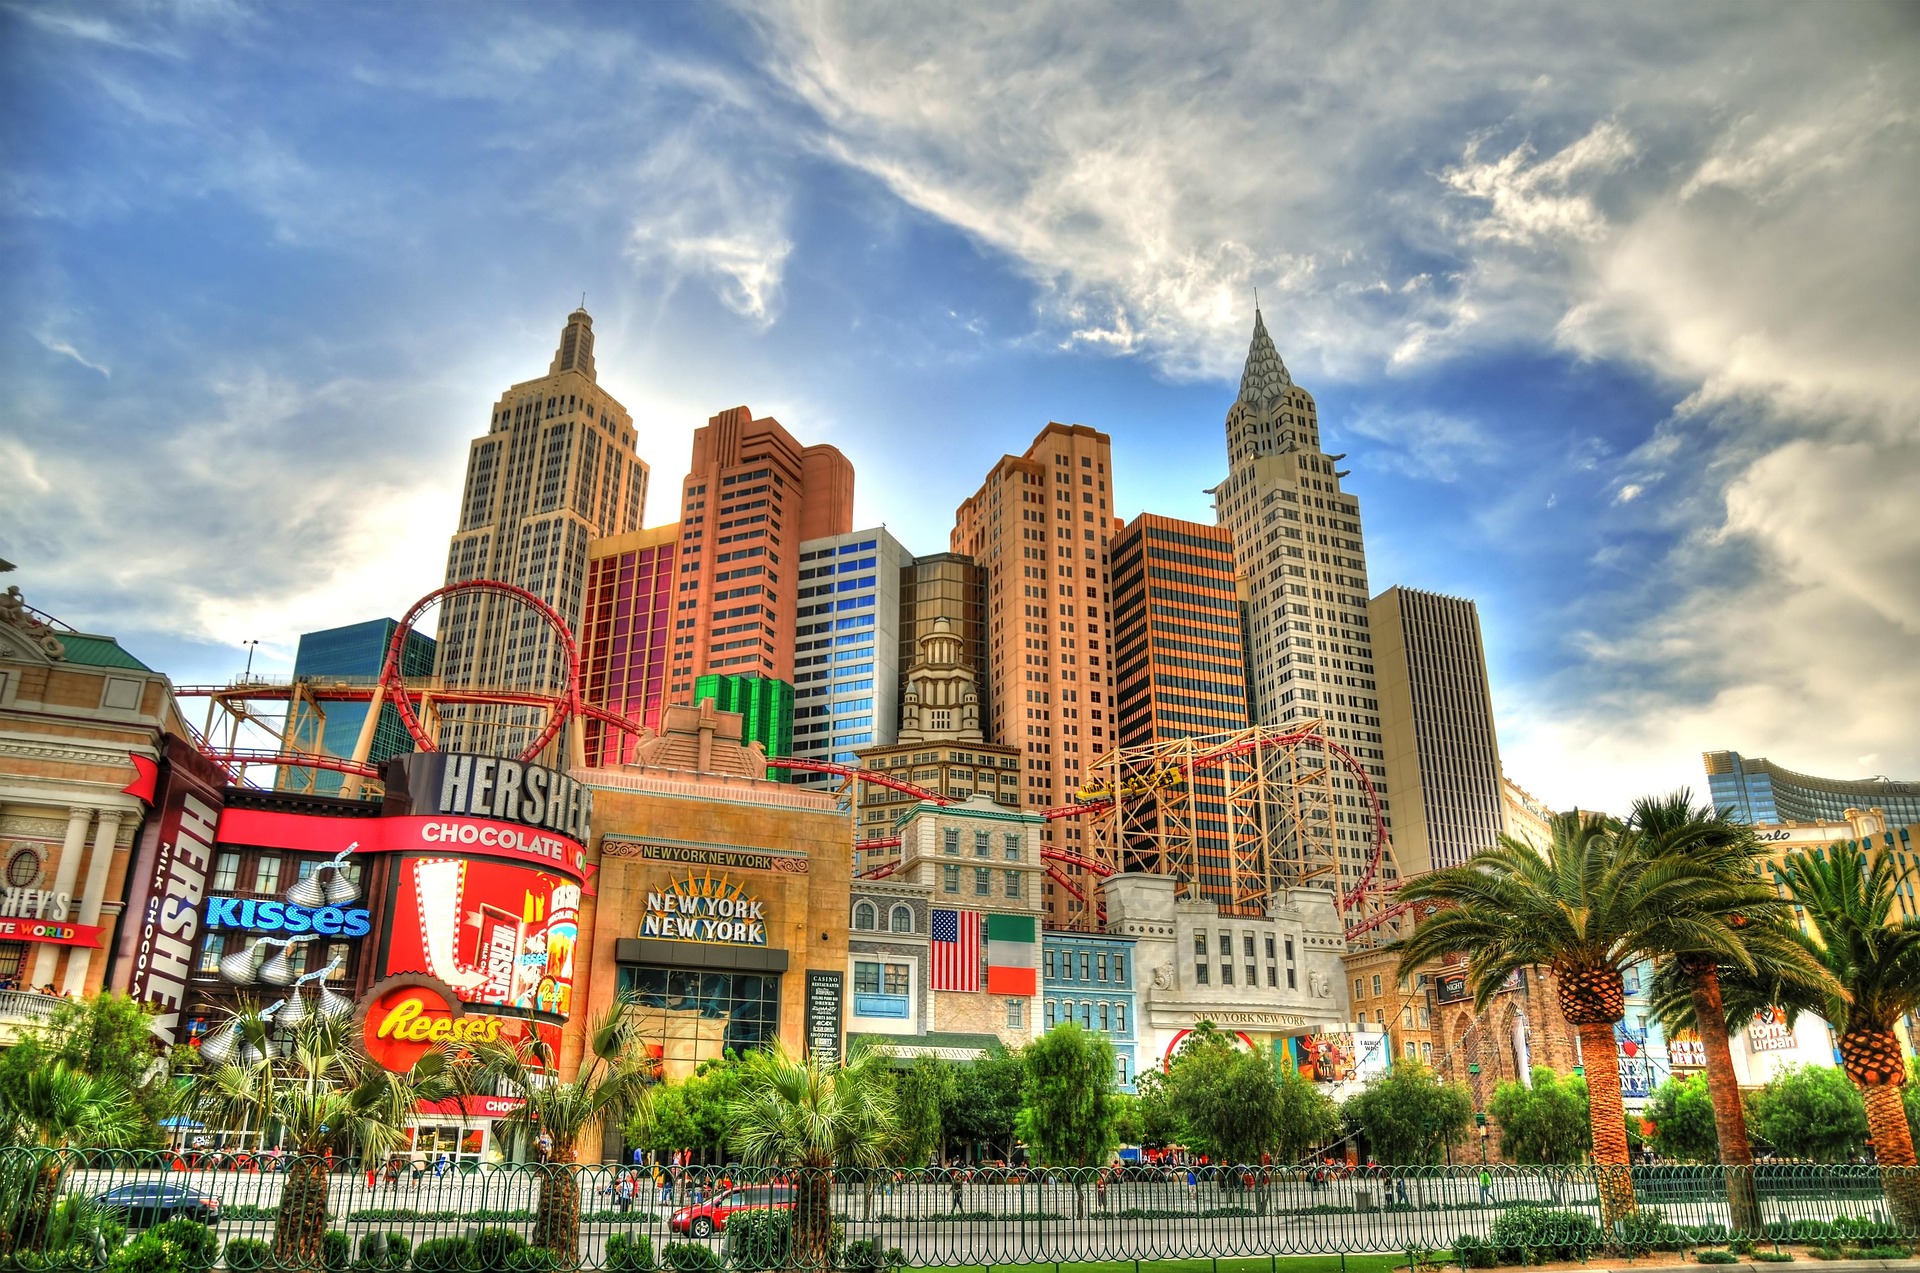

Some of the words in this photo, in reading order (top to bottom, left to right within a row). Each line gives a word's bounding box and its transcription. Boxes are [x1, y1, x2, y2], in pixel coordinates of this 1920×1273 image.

[421, 822, 563, 861] CHOCOLATE
[1753, 829, 1790, 841] arlo
[643, 845, 673, 860] NEW
[672, 848, 708, 863] YORK
[708, 852, 739, 866] NEW
[739, 855, 771, 869] YORK
[154, 842, 171, 890] MILK
[647, 891, 698, 914] NEW
[704, 897, 764, 920] YORK
[21, 924, 75, 938] WORLD
[645, 916, 698, 938] NEW
[702, 920, 764, 943] YORK
[377, 998, 503, 1043] Reese's
[1193, 1012, 1220, 1022] NEW
[1223, 1013, 1255, 1023] YORK
[1256, 1014, 1280, 1024] NEW
[1281, 1015, 1305, 1026] YORK
[1669, 1041, 1691, 1053] NEW
[1753, 1037, 1795, 1050] urban
[1618, 1058, 1642, 1074] NY
[1671, 1053, 1692, 1065] NEW
[1620, 1075, 1645, 1091] NY
